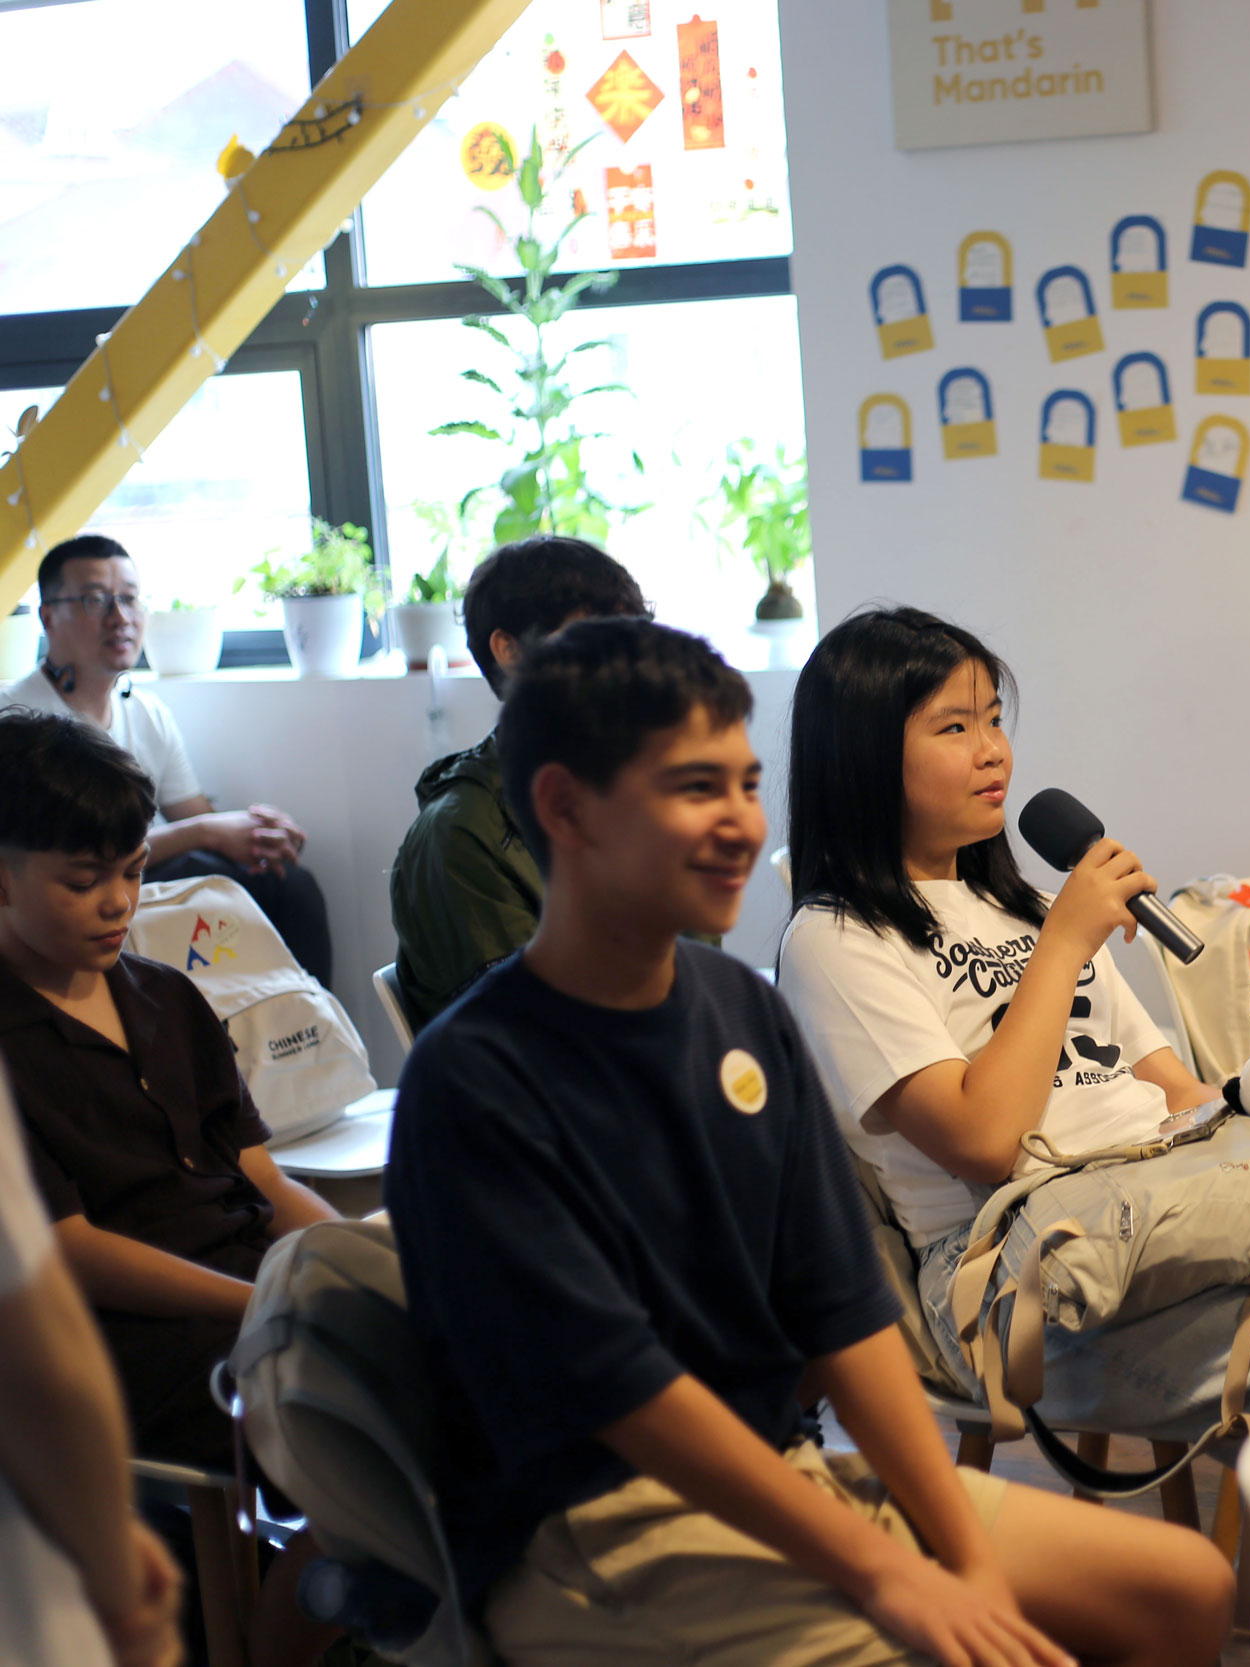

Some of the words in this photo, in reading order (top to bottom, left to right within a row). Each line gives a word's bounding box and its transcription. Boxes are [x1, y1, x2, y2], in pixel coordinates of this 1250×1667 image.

[931, 28, 1044, 67] That's
[933, 63, 1104, 105] Mandarin
[268, 1024, 320, 1052] CHINESE
